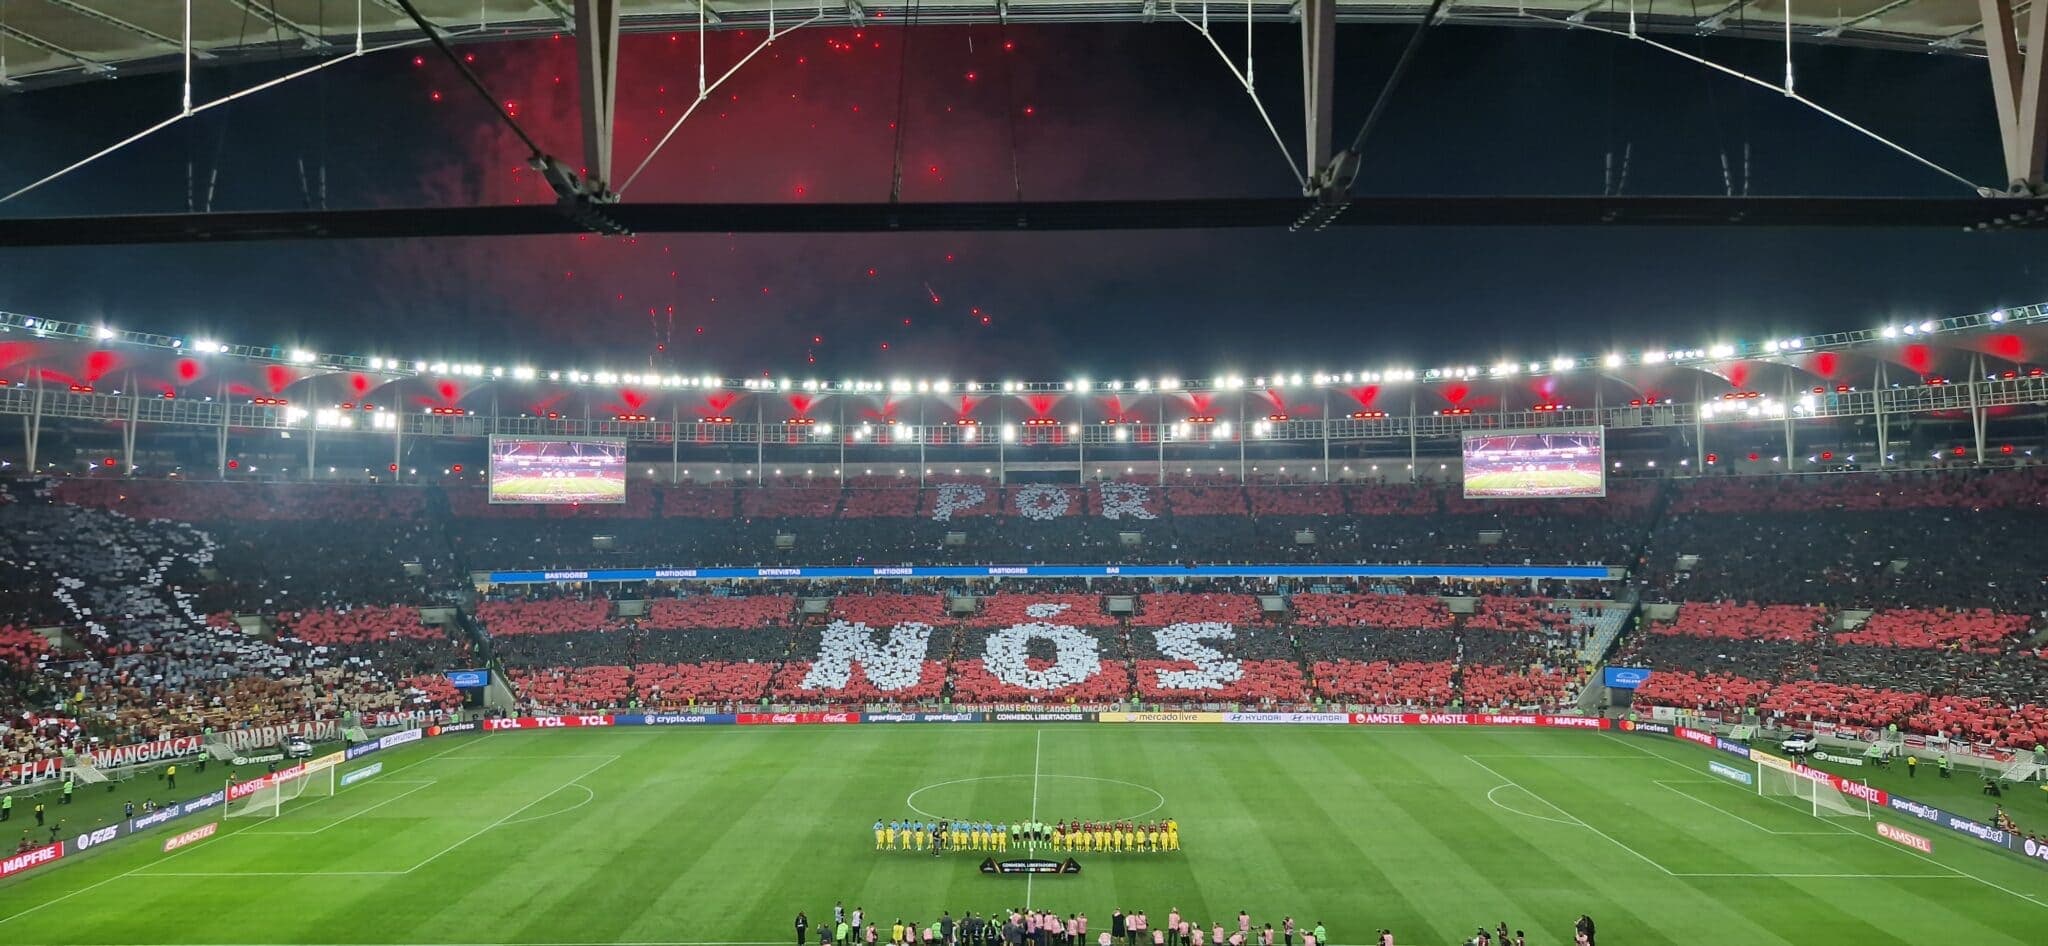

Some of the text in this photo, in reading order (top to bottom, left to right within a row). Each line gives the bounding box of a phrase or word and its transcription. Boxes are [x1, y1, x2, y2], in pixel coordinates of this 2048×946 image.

[933, 481, 1158, 521] POR
[799, 603, 1243, 690] NÓS
[535, 717, 565, 727] TCL
[579, 716, 608, 726] TCL
[657, 714, 705, 725] crypto.com
[868, 714, 916, 723] sportingbet
[924, 714, 972, 722] sportingbet
[997, 713, 1083, 721] CONMEBOL LIBERTADORES
[1139, 713, 1198, 721] mercado livre
[1366, 714, 1404, 724] AMSTEL
[1429, 714, 1468, 724] AMSTEL
[1493, 715, 1537, 724] MAPFRE
[1554, 718, 1599, 727] MAPFRE
[441, 723, 475, 734] priceless
[492, 719, 521, 728] TCL
[1635, 722, 1669, 733] priceless
[1686, 729, 1714, 744] MAPFRE
[98, 737, 198, 768] MANGUAÇA
[1722, 742, 1749, 756] crypto.com
[21, 759, 56, 784] FLA
[238, 778, 265, 796] AMSTEL
[1849, 782, 1879, 803] AMSTEL
[1892, 799, 1938, 821] sportingbet
[136, 805, 179, 829] sportingbet
[177, 824, 216, 846] AMSTEL
[1950, 819, 2003, 843] sportingbet
[1888, 831, 1929, 851] AMSTEL
[3, 847, 55, 874] MAPFRE
